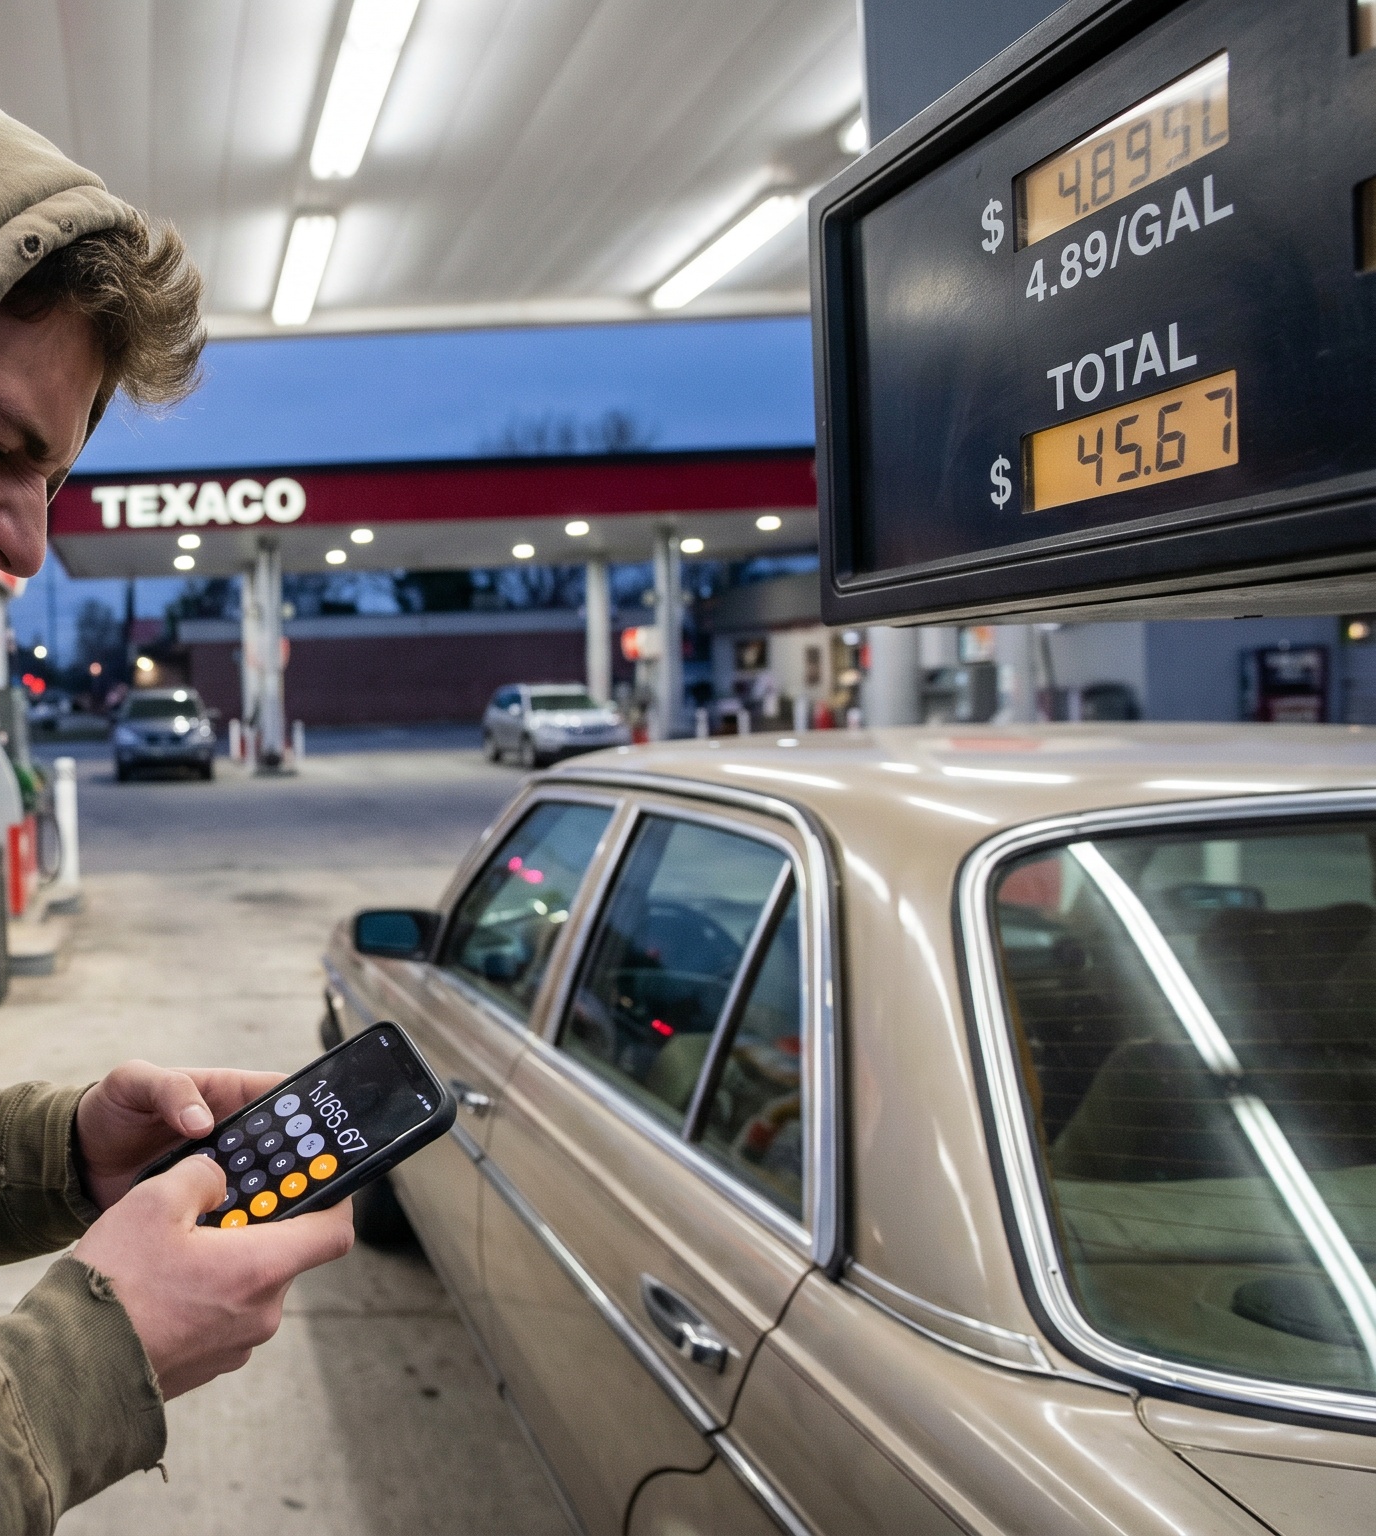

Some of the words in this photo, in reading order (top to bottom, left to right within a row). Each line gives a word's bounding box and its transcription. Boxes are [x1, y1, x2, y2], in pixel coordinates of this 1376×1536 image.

[981, 198, 1005, 254] $
[1026, 174, 1234, 303] 4.89/GAL
[1047, 322, 1198, 411] TOTAL
[990, 454, 1012, 510] $
[1077, 386, 1233, 487] 45.67
[91, 477, 307, 529] TEXACO
